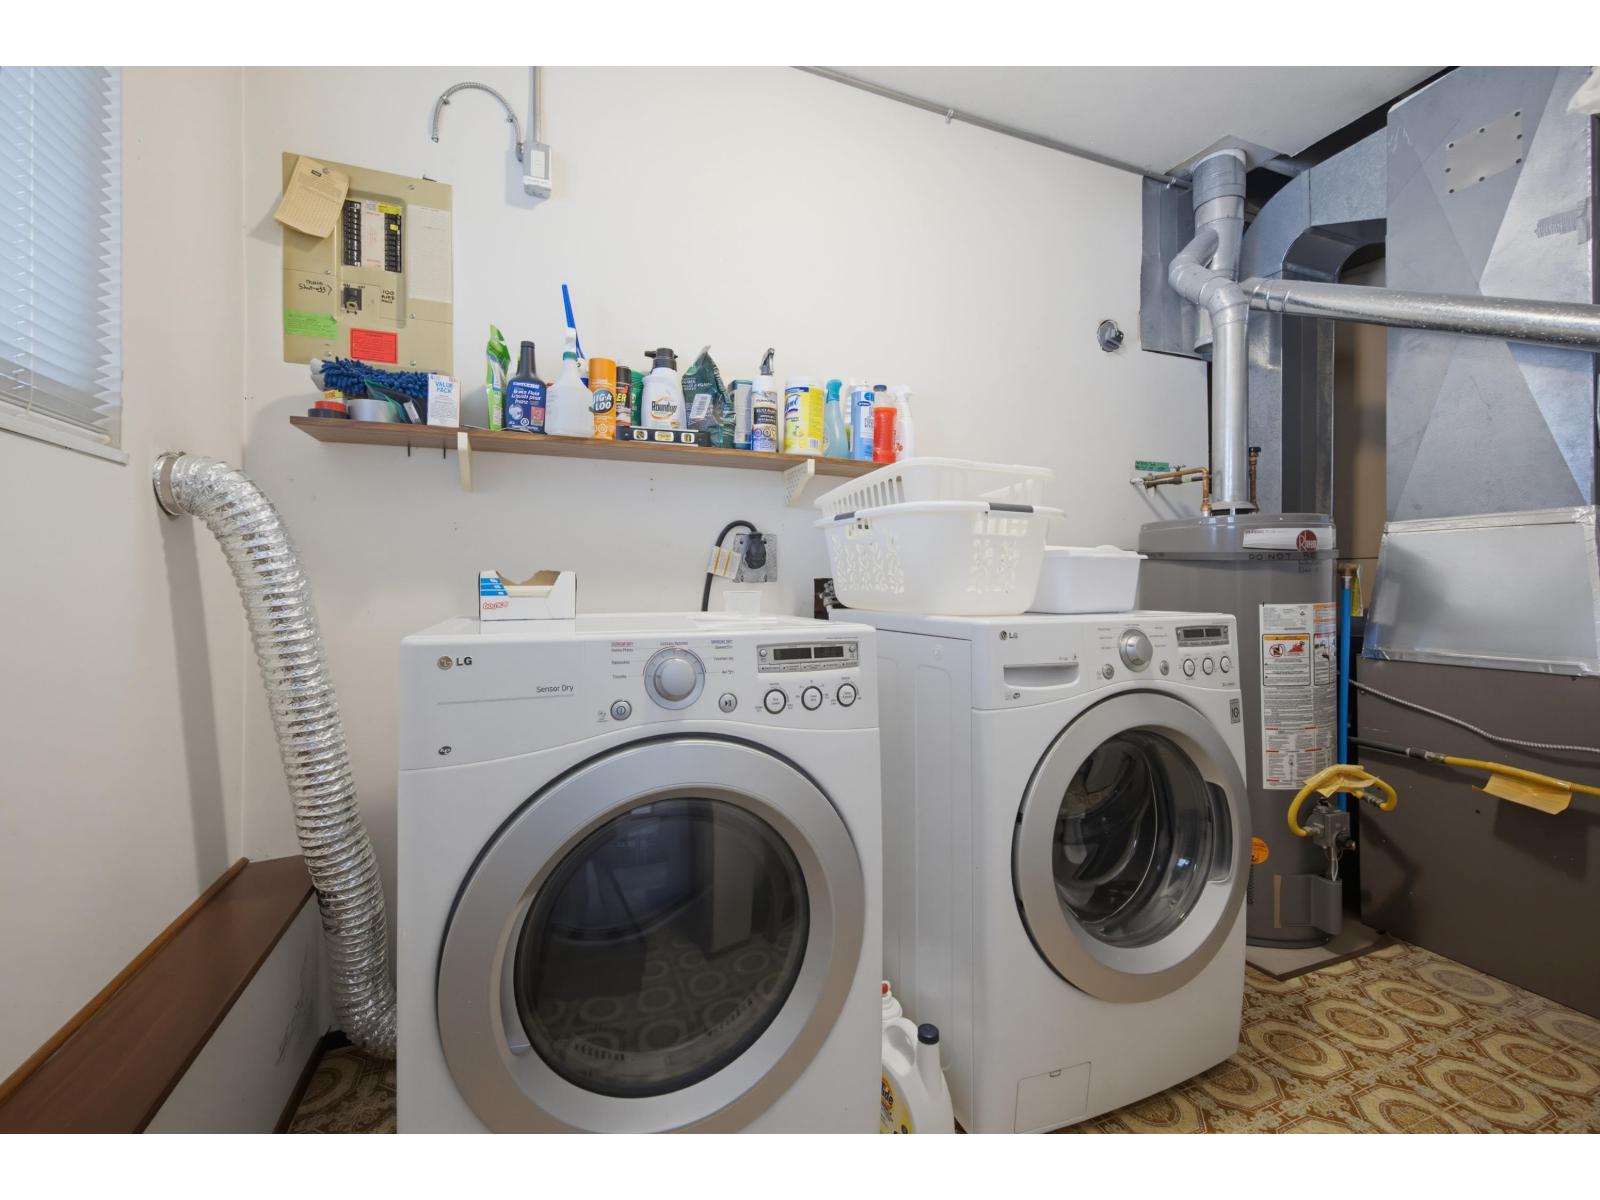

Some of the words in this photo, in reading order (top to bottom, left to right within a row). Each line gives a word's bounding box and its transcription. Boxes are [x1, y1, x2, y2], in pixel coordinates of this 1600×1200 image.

[595, 401, 612, 411] LOO
[651, 400, 677, 413] Roundup
[1267, 552, 1292, 560] NOT
[455, 656, 473, 666] LG
[536, 685, 560, 693] Sensor
[561, 684, 574, 692] Dry
